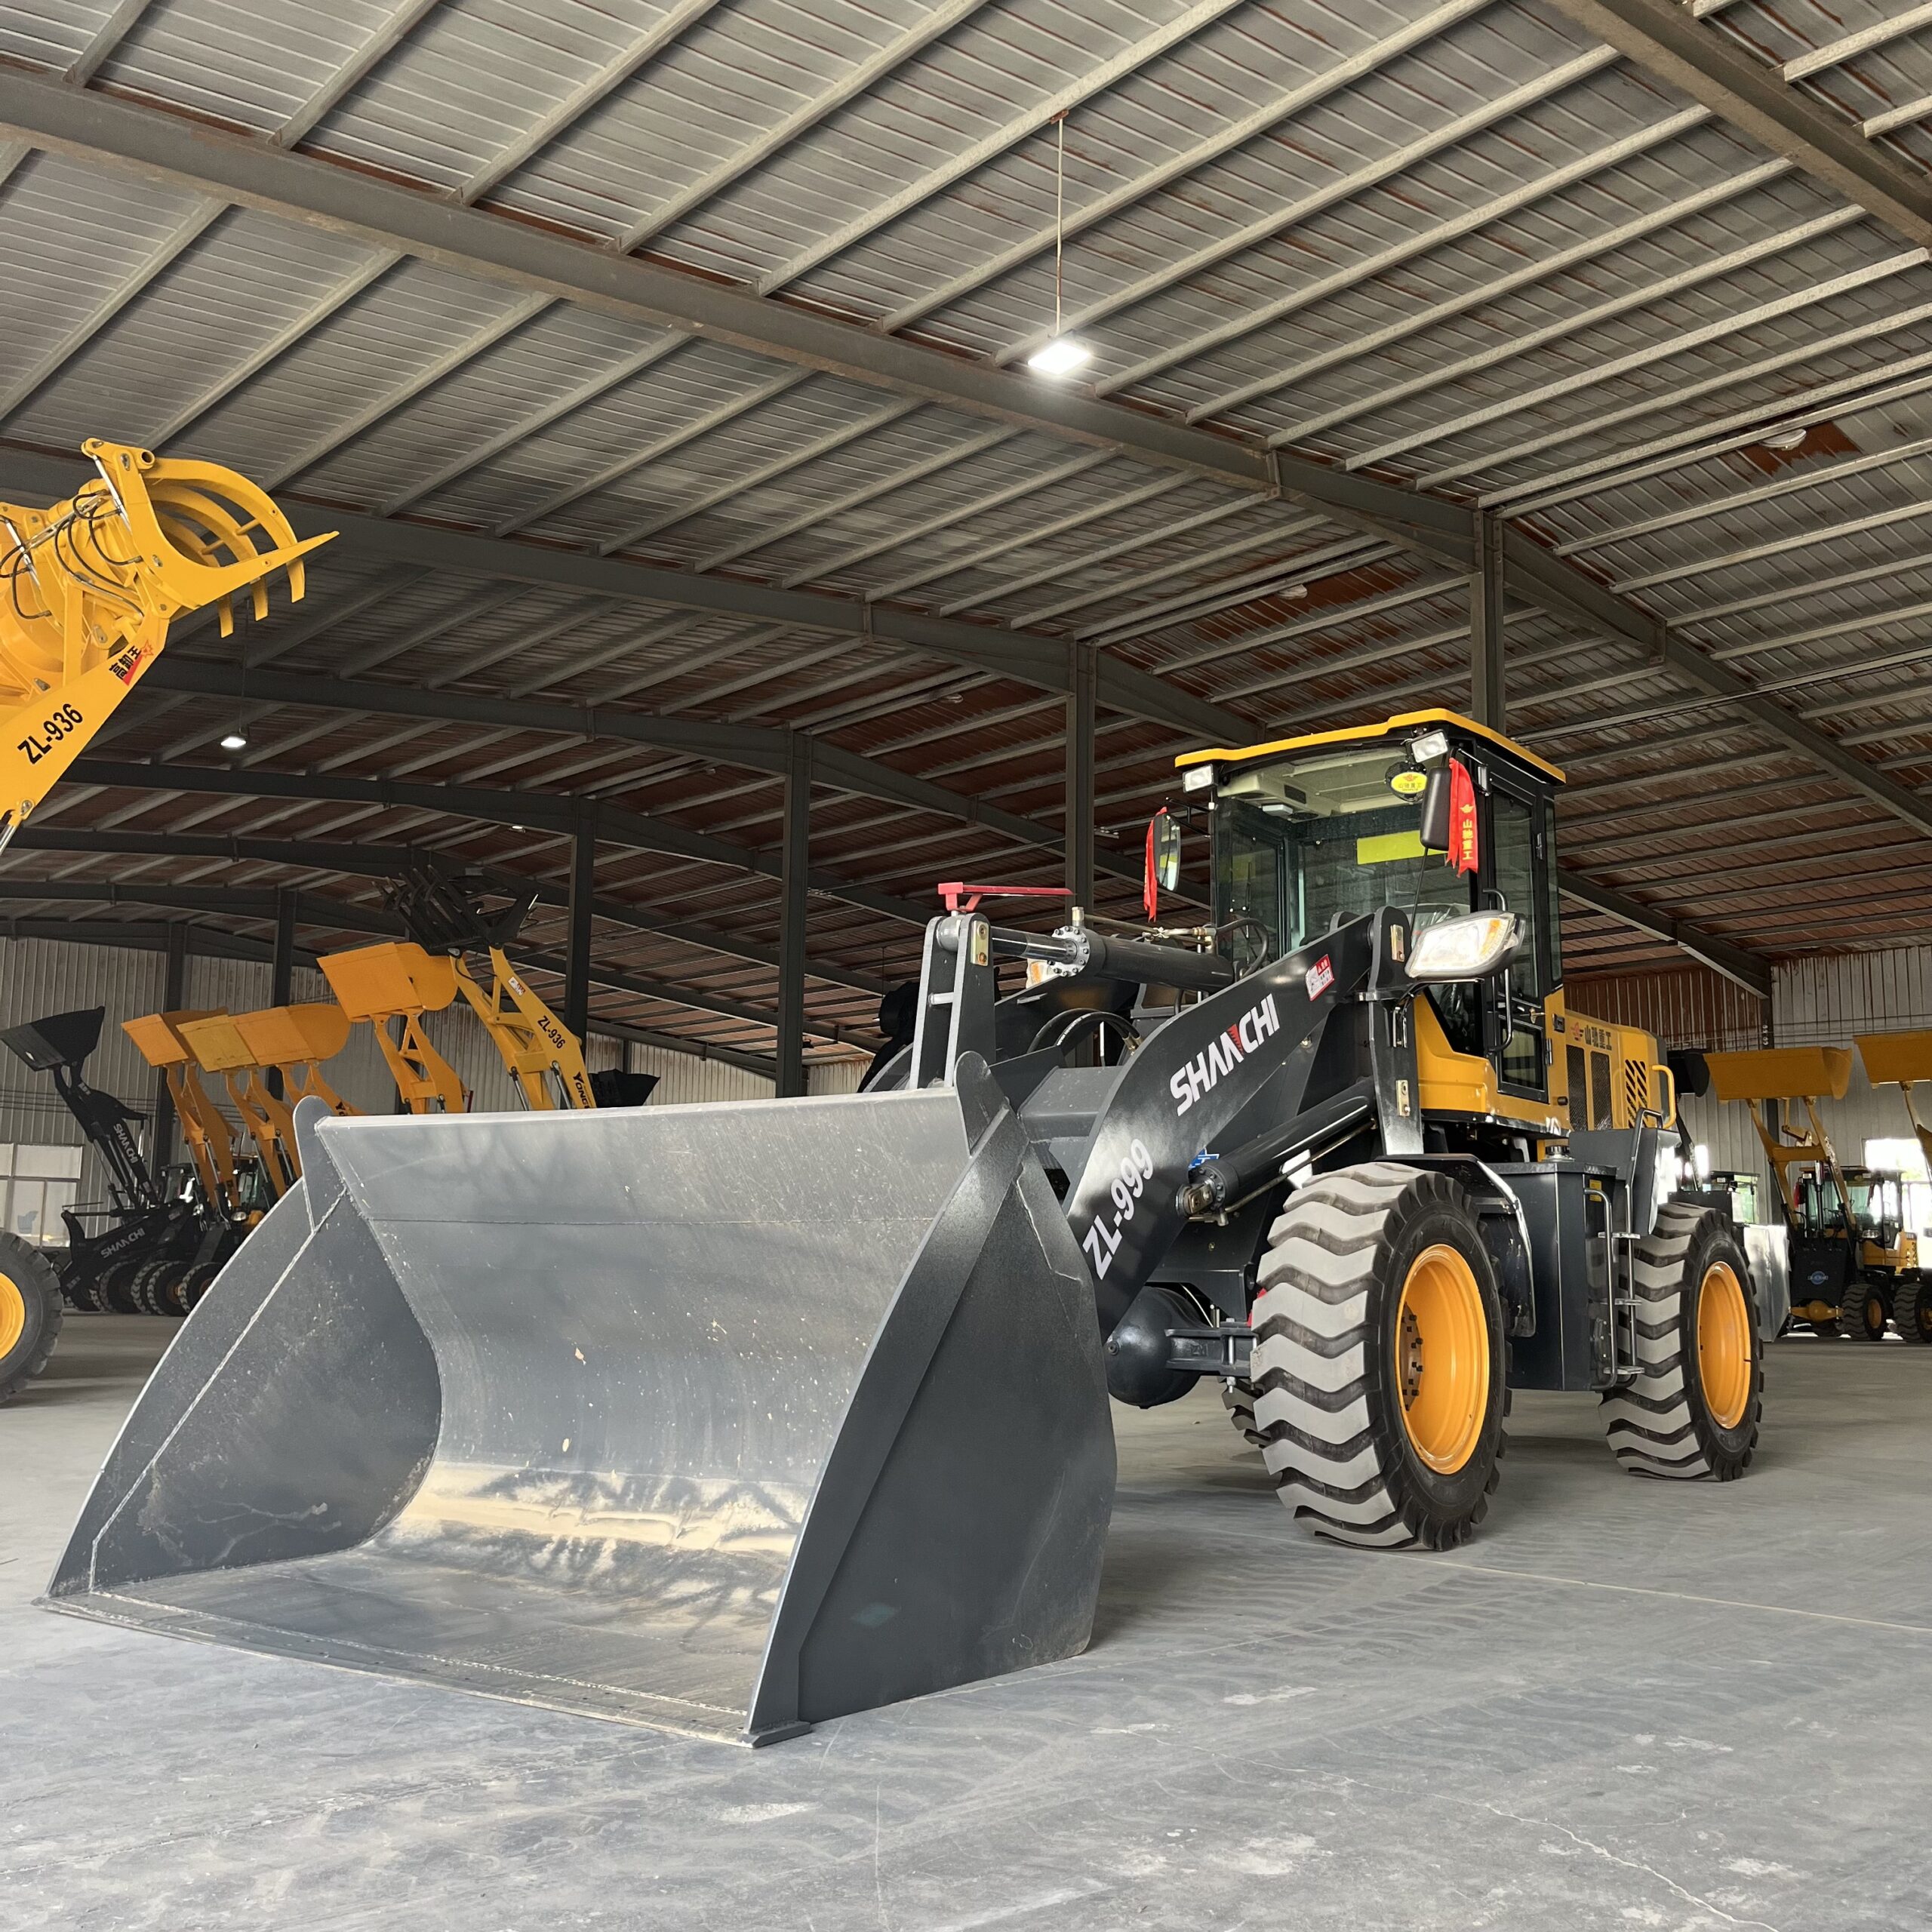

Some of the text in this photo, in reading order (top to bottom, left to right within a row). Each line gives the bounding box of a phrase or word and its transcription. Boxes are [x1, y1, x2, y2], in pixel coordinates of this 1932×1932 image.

[17, 703, 83, 764] ZL-936
[537, 1015, 566, 1049] ZL-936
[1170, 993, 1280, 1117] SHANCHI
[1082, 1139, 1153, 1280] ZL-999
